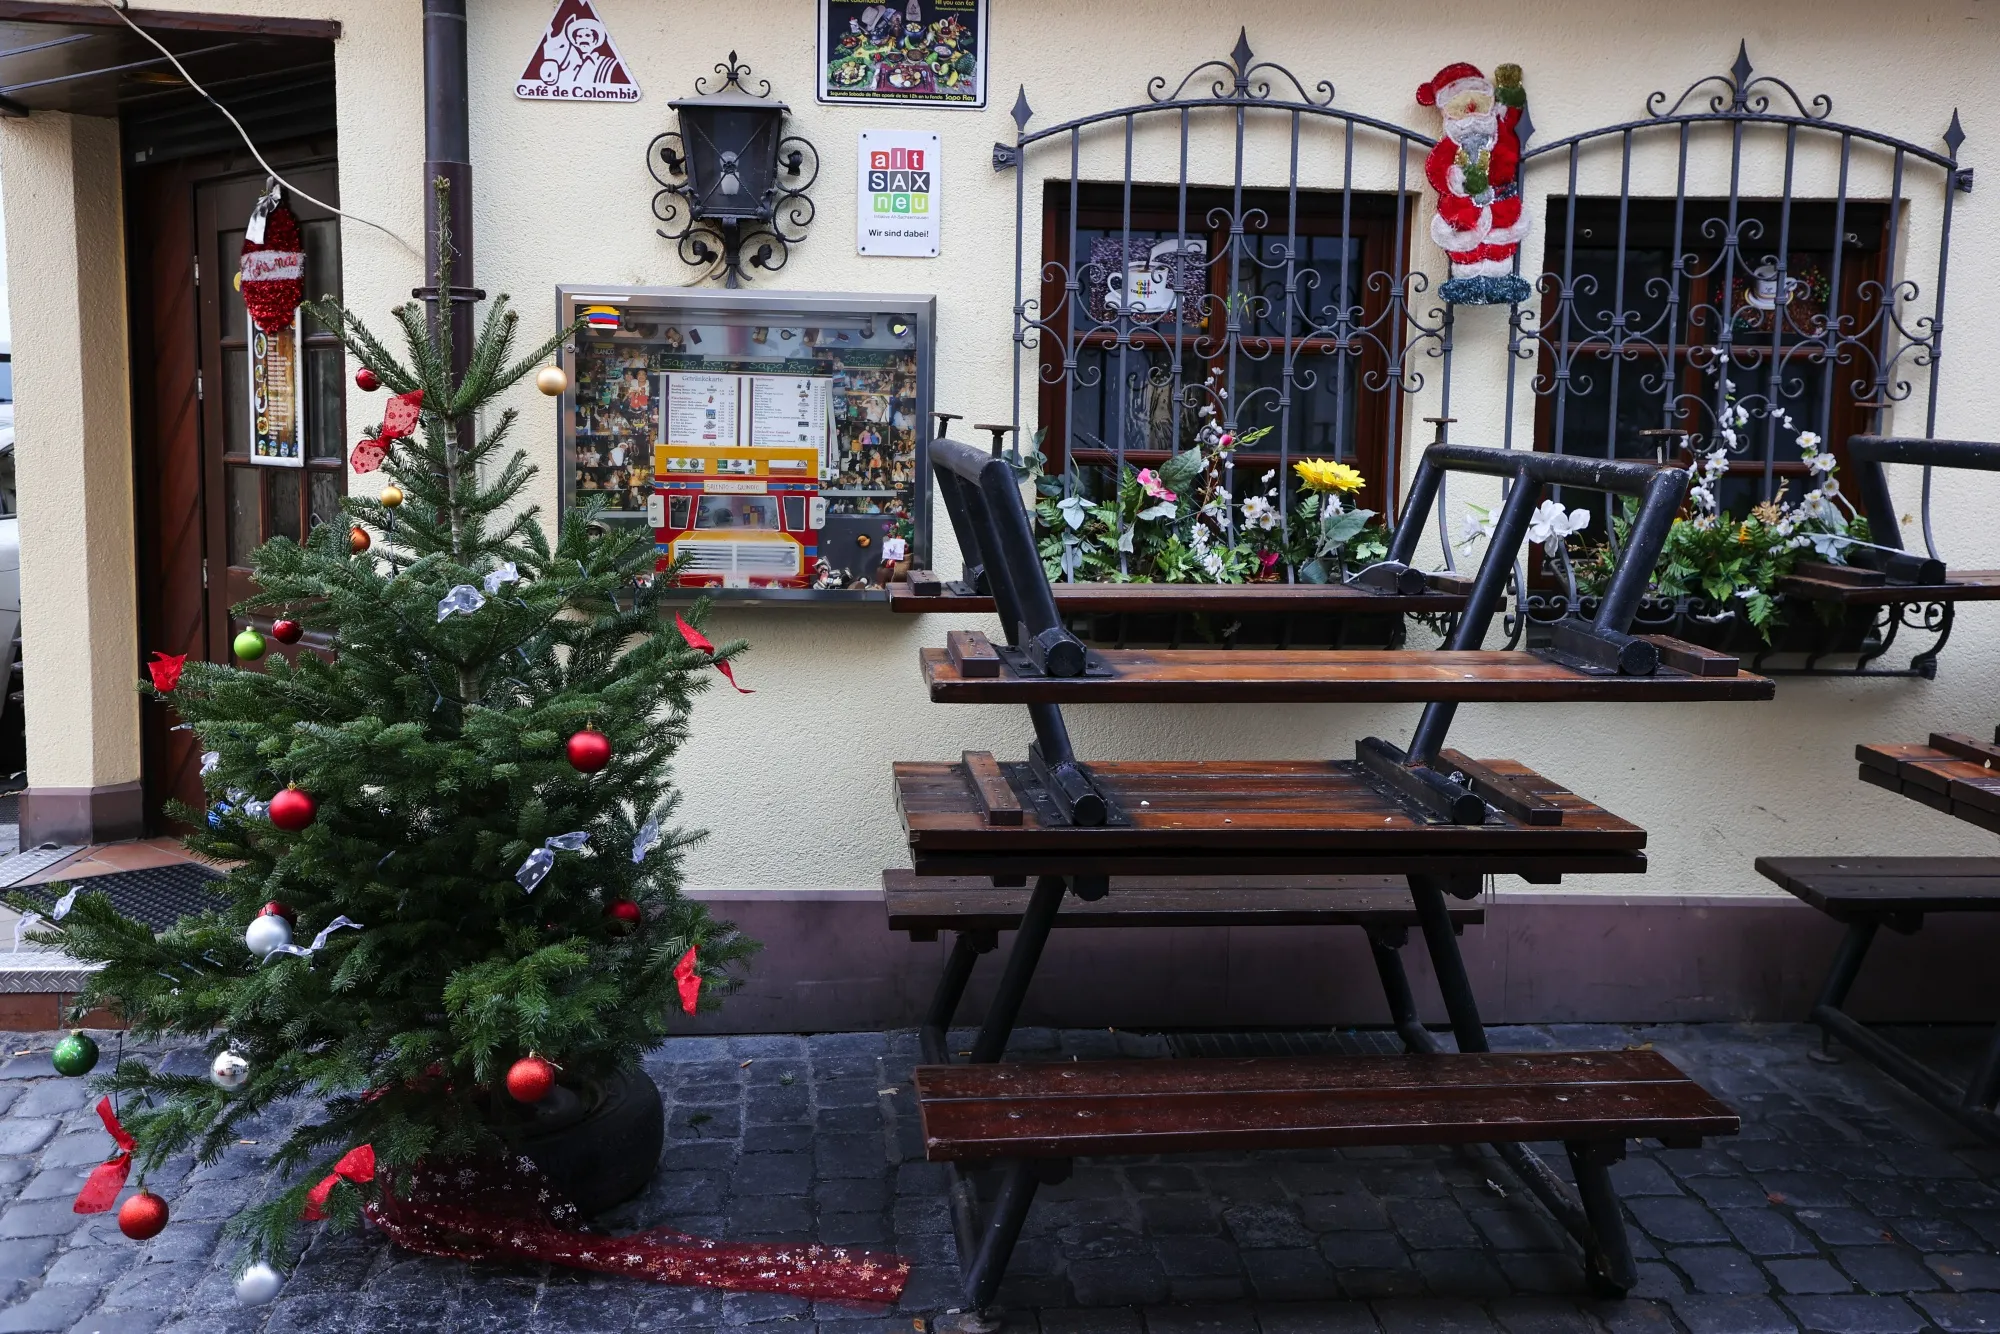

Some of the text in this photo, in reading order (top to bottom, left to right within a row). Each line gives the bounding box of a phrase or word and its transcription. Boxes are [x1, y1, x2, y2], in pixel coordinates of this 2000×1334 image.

[516, 84, 638, 100] Café de Colombia
[945, 93, 961, 101] Sapo
[962, 94, 975, 103] Rey
[874, 150, 920, 168] alt
[871, 172, 928, 191] SAX
[877, 196, 925, 210] neu
[868, 229, 929, 238] Wir sind dabei!
[662, 358, 697, 370] Sapo
[748, 361, 815, 375] Sapo Rey
